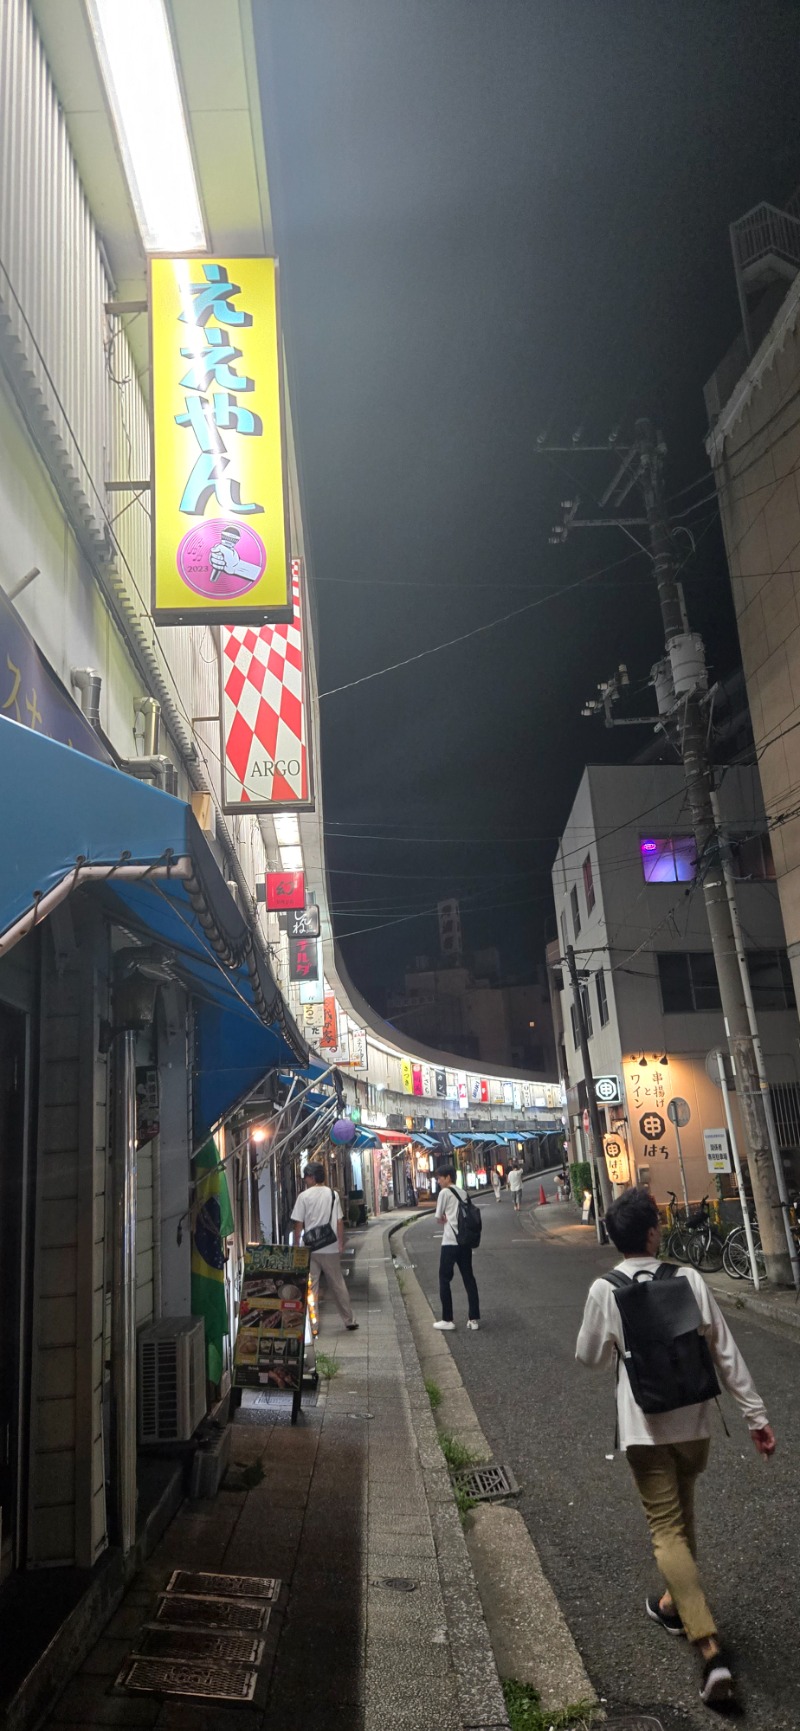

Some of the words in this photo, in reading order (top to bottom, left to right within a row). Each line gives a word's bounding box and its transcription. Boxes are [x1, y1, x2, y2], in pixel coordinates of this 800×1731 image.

[175, 264, 265, 516] ええやん
[187, 565, 209, 573] 2023
[250, 759, 301, 778] ARGO
[630, 1074, 644, 1109] ワイン
[644, 1087, 652, 1096] と
[652, 1071, 665, 1108] 串揚げ
[643, 1144, 670, 1160] はち
[609, 1160, 619, 1180] はち
